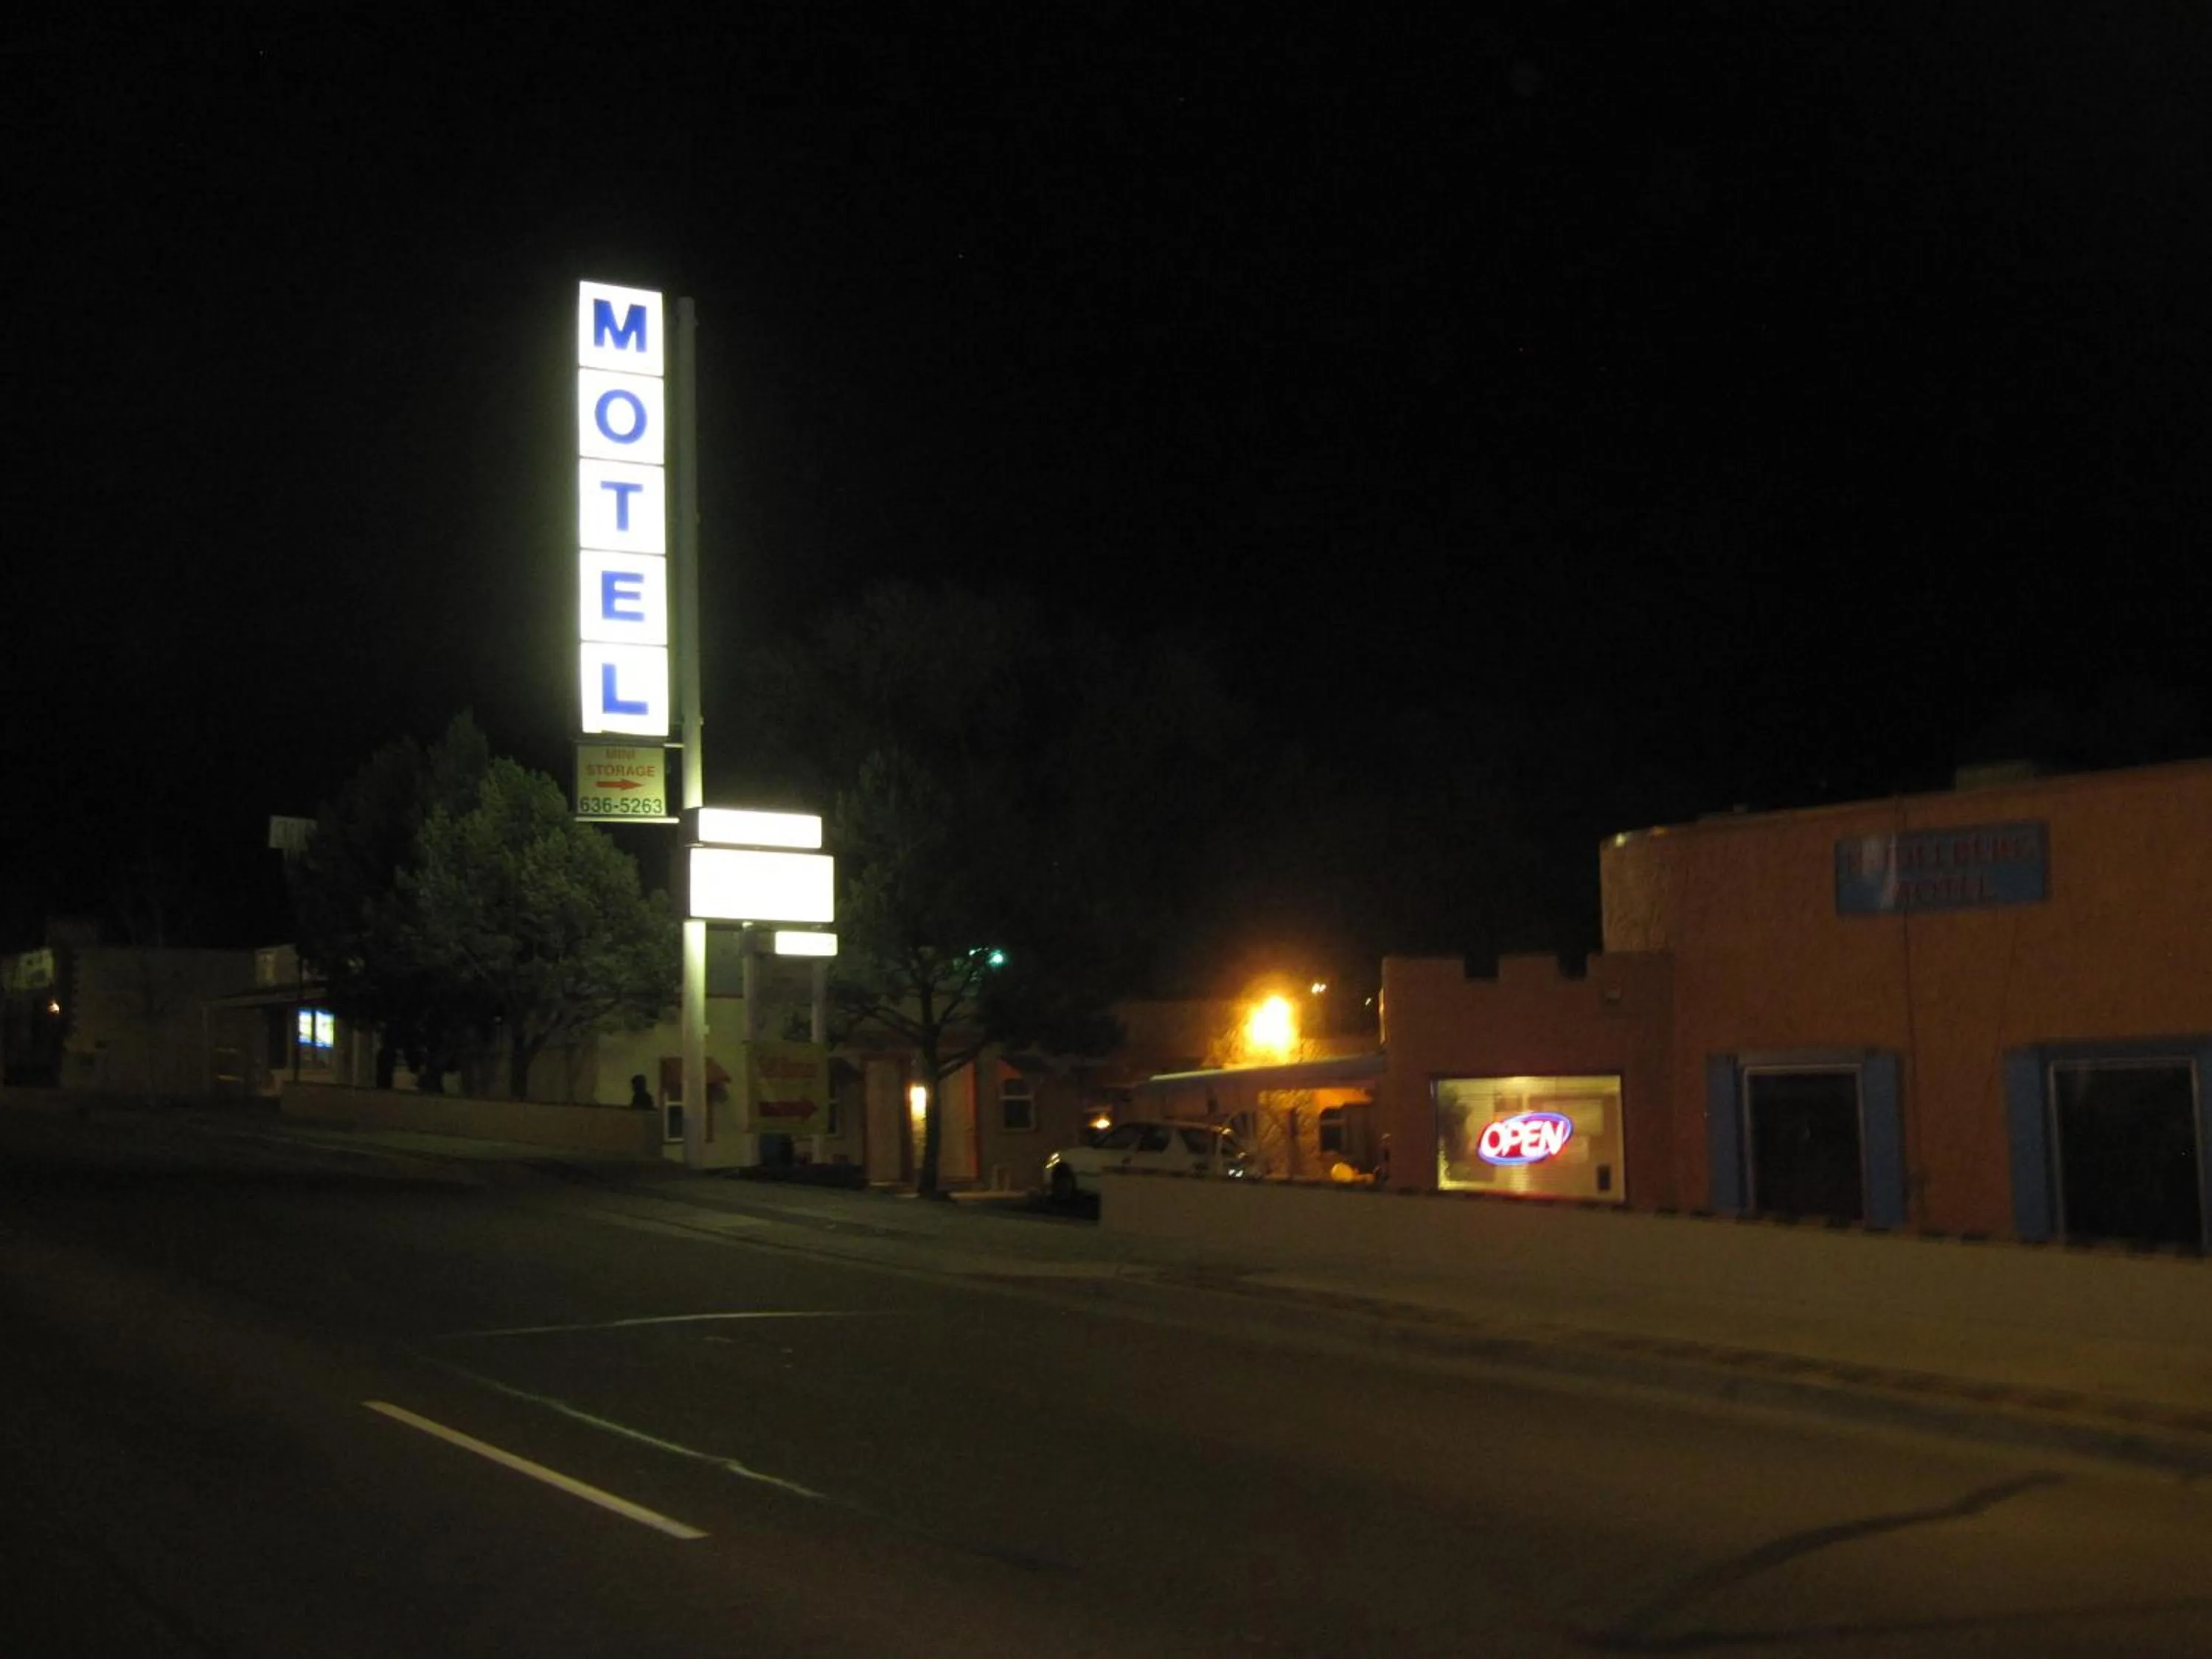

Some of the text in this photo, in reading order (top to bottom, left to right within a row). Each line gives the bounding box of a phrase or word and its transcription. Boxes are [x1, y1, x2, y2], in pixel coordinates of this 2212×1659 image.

[592, 298, 649, 716] MOTEL
[587, 763, 655, 777] STORAGE
[580, 797, 663, 814] 636-5263
[1480, 1119, 1565, 1158] OPEN
